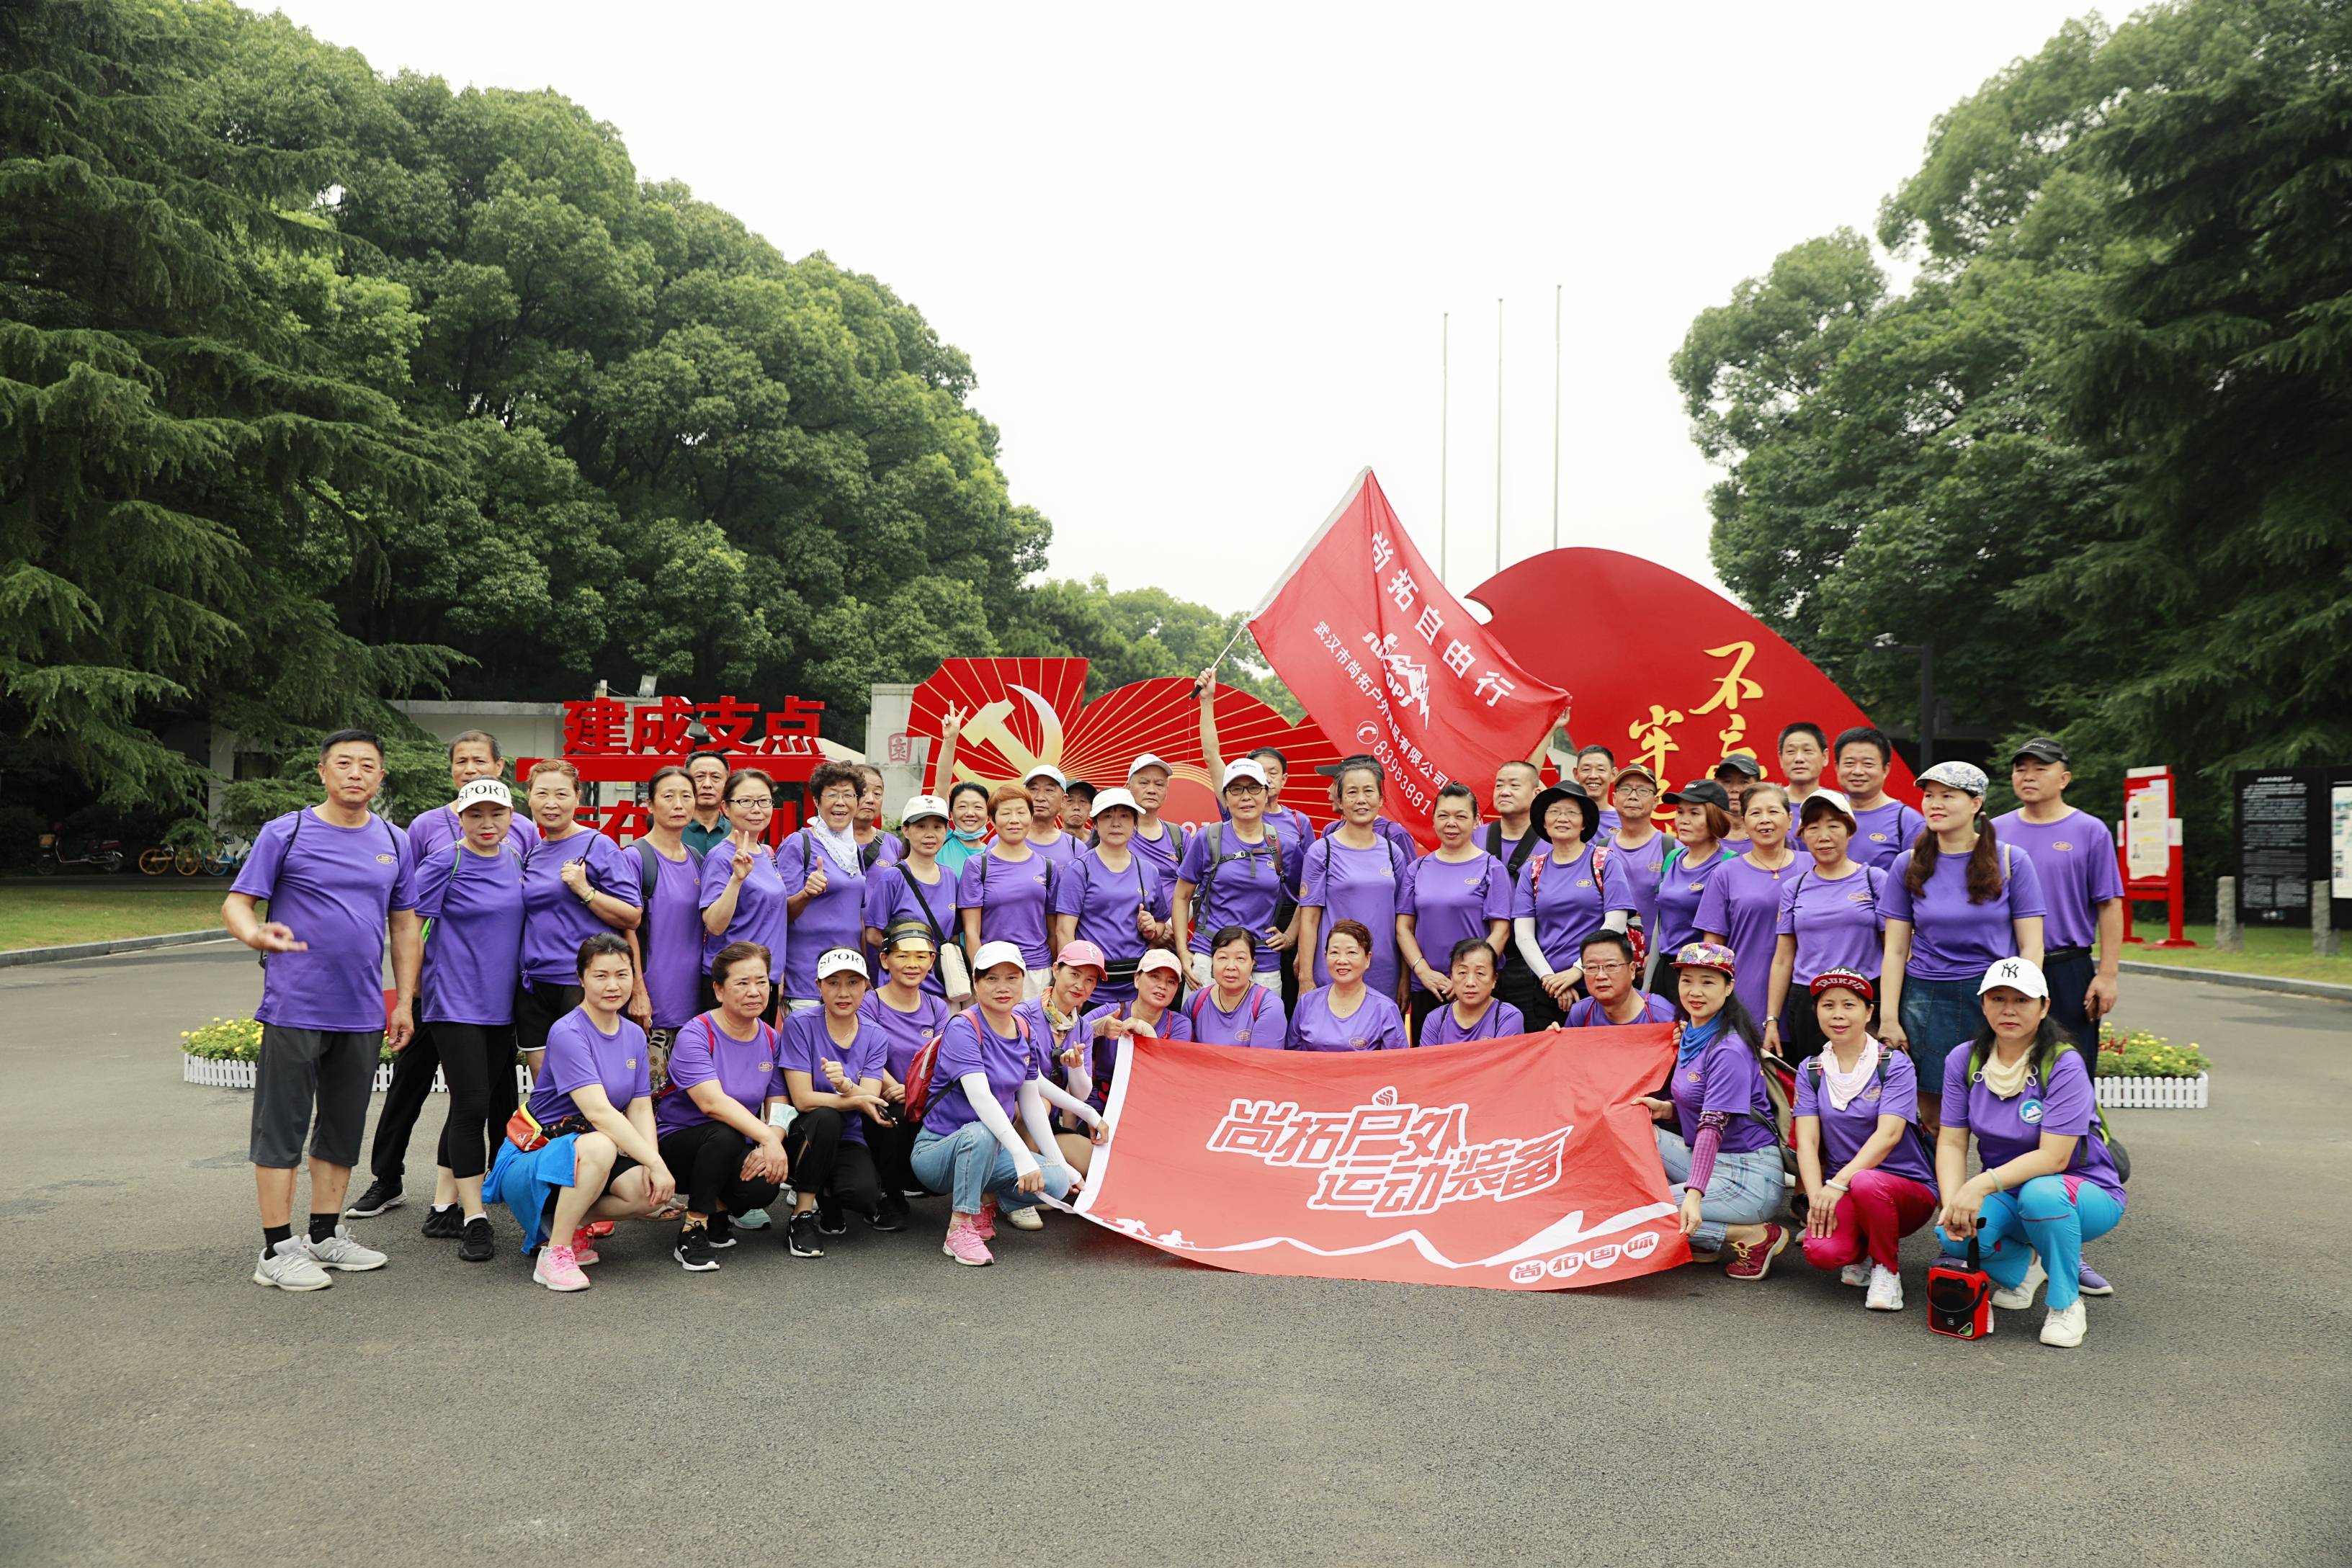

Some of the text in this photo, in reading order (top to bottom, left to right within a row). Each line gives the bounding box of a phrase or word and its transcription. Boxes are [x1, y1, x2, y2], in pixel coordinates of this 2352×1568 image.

[1372, 531, 1515, 708] 尚拓自由行
[562, 696, 826, 756] 建成支点
[1314, 621, 1449, 790] 武汉市尚拓户外用品有限公司
[459, 784, 508, 802] SPORT
[1373, 740, 1432, 816] 83983881
[1815, 978, 1866, 990] TRUKFIT
[1207, 1086, 1469, 1168] 尚拓户外
[1307, 1125, 1575, 1218] 运动装备
[1508, 1230, 1660, 1284] 尚拓国际
